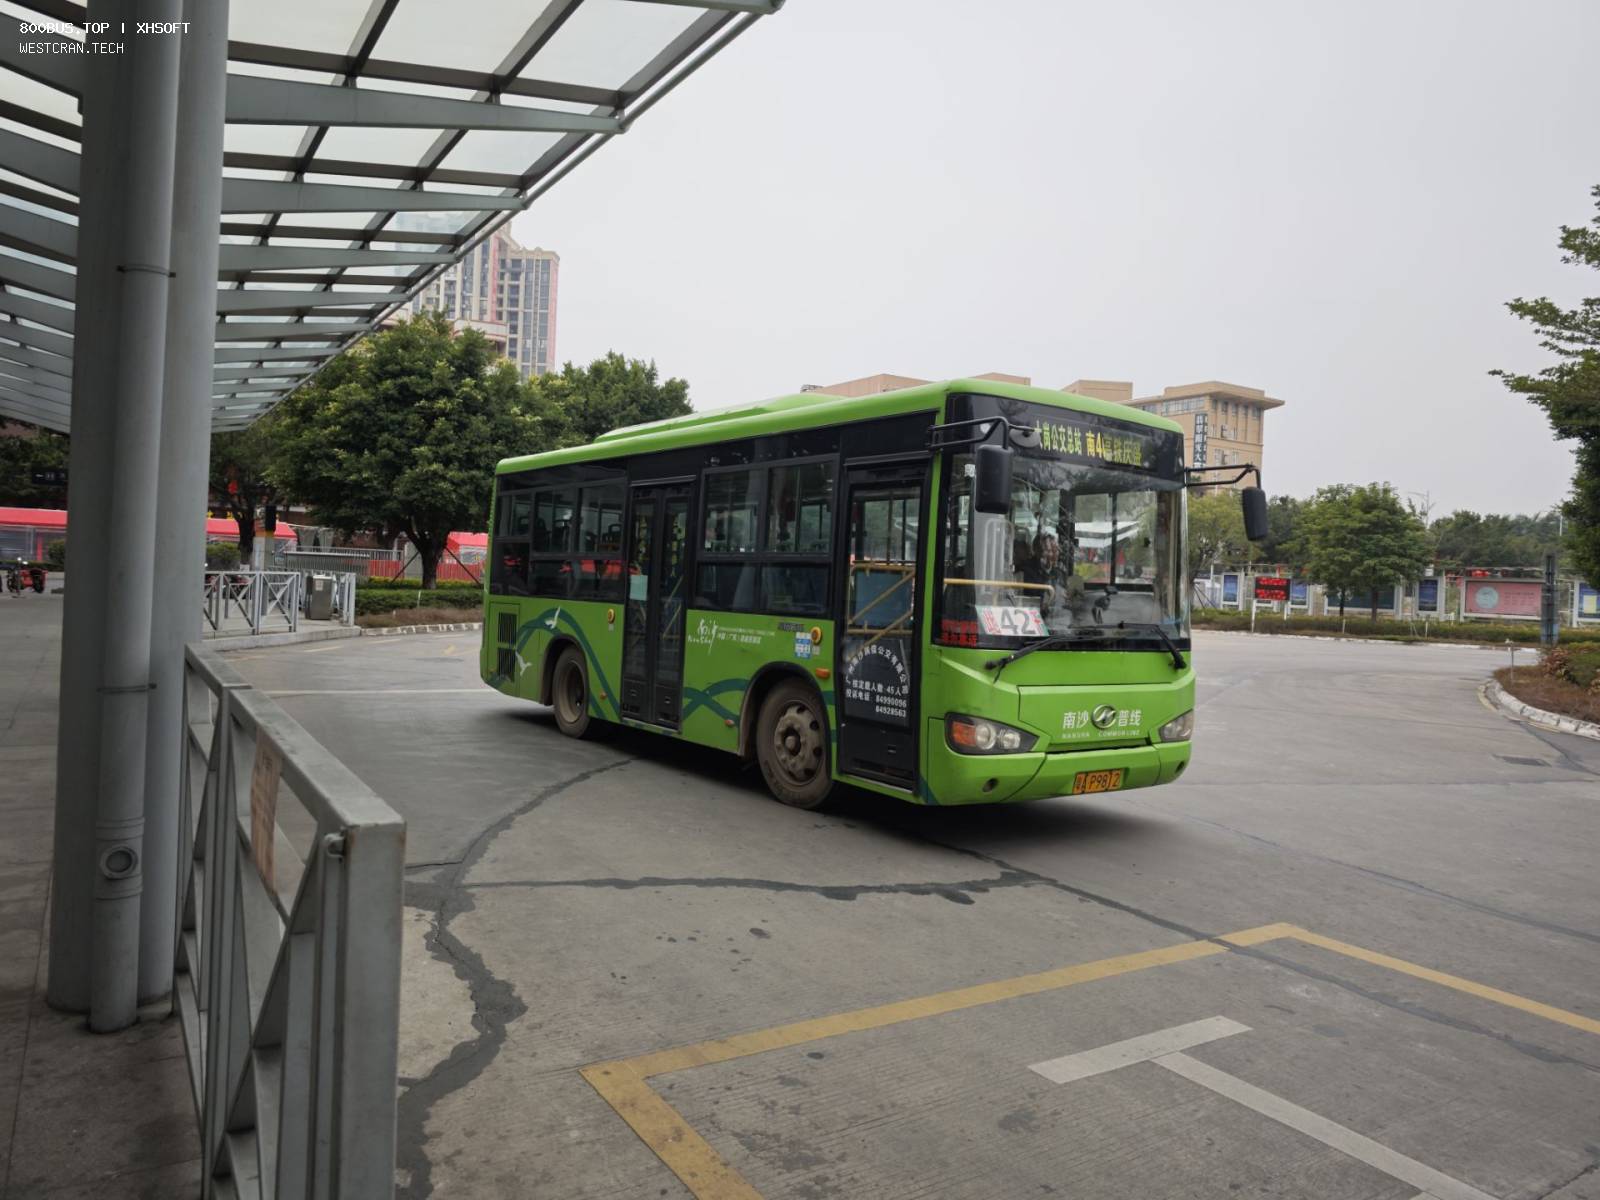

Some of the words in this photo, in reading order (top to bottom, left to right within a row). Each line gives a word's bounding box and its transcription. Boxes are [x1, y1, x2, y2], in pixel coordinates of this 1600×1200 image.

[1001, 608, 1036, 635] 42
[1062, 710, 1089, 729] 南沙
[1118, 708, 1142, 727] 普线
